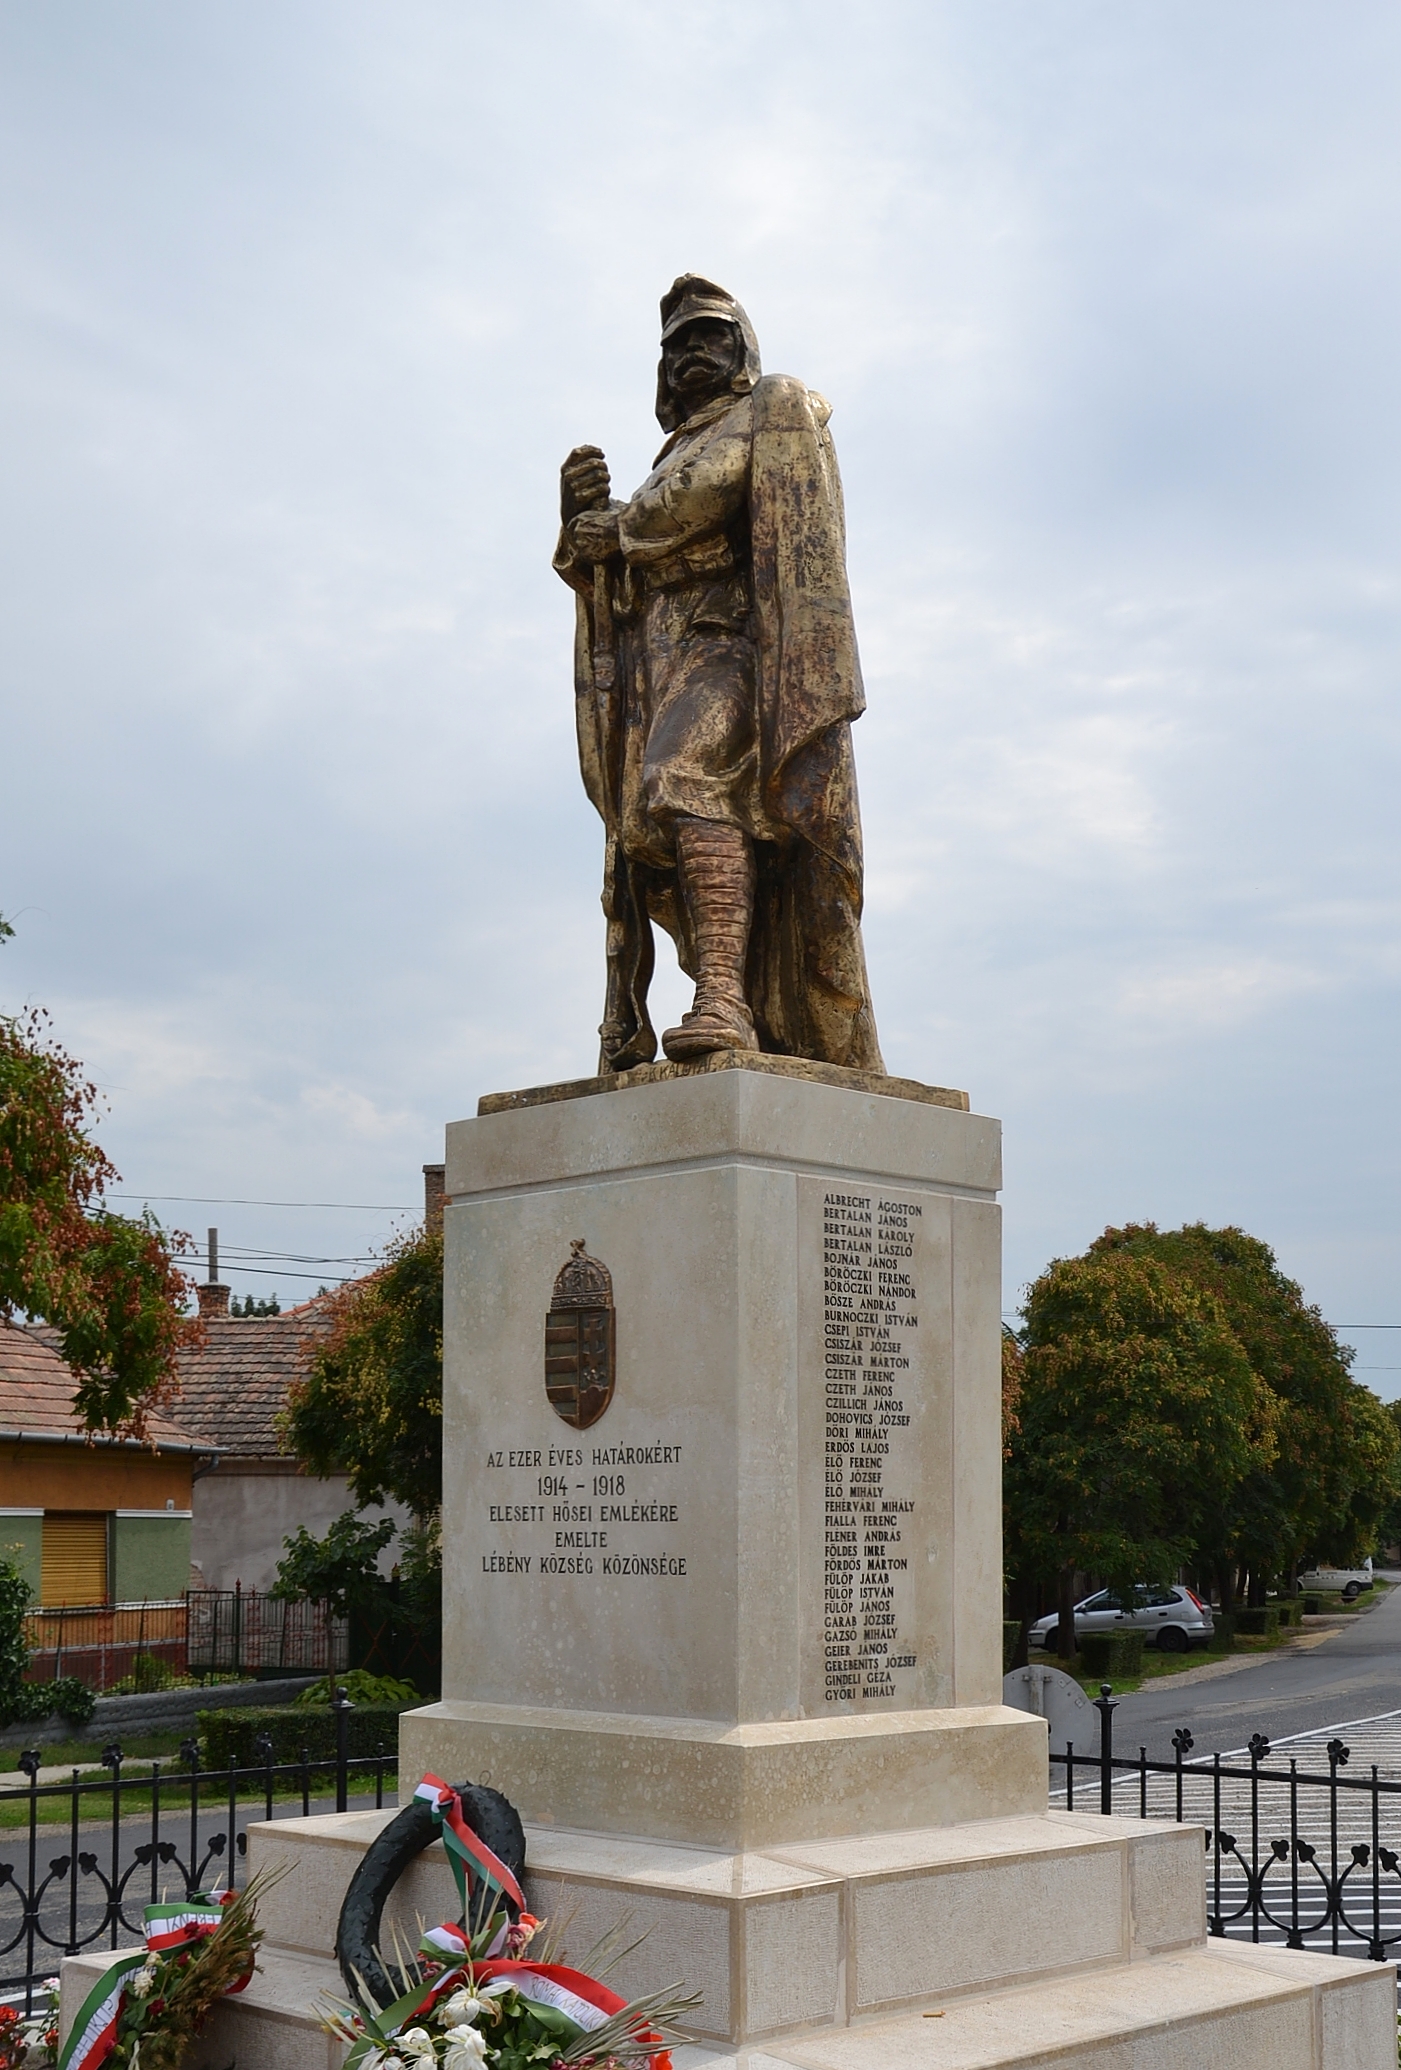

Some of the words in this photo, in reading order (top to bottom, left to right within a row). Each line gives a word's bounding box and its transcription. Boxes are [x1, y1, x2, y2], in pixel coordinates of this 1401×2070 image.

[824, 1194, 871, 1209] ALBRECHT
[878, 1197, 922, 1216] ÁGOSTON
[824, 1208, 871, 1223] BERTALAN
[878, 1213, 908, 1227] JÁNOS
[824, 1223, 871, 1238] BERTALAN
[878, 1227, 914, 1243] KÁROLY
[824, 1238, 871, 1253] BERTALAN
[878, 1242, 912, 1257] LÁSZLÓ
[824, 1252, 861, 1266] BOJNÁR
[868, 1254, 897, 1269] JÁNOS
[879, 1272, 910, 1285] FERENC
[879, 1284, 916, 1299] NÁNDOR
[860, 1298, 896, 1311] ANDRÁS
[825, 1310, 878, 1324] BURNOCZKI
[885, 1313, 918, 1327] ISTVÁN
[825, 1324, 849, 1336] CSEPI
[856, 1325, 889, 1338] ISTVÁN
[825, 1337, 863, 1351] CSISZÁR
[870, 1339, 901, 1353] JÓZSEF
[825, 1352, 863, 1366] CSISZÁR
[870, 1354, 909, 1368] MÁRTON
[826, 1368, 856, 1380] CZETH
[863, 1371, 895, 1382] FERENC
[826, 1383, 856, 1395] CZETH
[863, 1382, 893, 1396] JÁNOS
[826, 1398, 866, 1410] CZILLICH
[874, 1398, 903, 1411] JÁNOS
[826, 1412, 872, 1424] DOHOVICS
[879, 1412, 910, 1426] JÓZSEF
[855, 1425, 888, 1439] MIHÁLY
[487, 1452, 503, 1467] AZ
[509, 1451, 541, 1467] EZER
[549, 1444, 583, 1465] ÉVES
[593, 1440, 682, 1465] HATÁROKÉRT
[861, 1443, 889, 1453] LAJOS
[850, 1457, 882, 1468] FERENC
[850, 1469, 881, 1483] JÓZSEF
[538, 1476, 568, 1496] 1914
[593, 1475, 625, 1496] 1918
[850, 1484, 883, 1497] MIHÁLY
[490, 1506, 544, 1521] ELESETT
[600, 1500, 678, 1522] EMLÉKÉRE
[825, 1498, 874, 1512] FEHÉRVÁRI
[882, 1498, 915, 1512] MIHÁLY
[825, 1516, 856, 1526] FIALLA
[863, 1516, 897, 1526] FERENC
[556, 1532, 607, 1547] EMELTE
[865, 1528, 901, 1542] ANDRÁS
[864, 1546, 885, 1556] IMRE
[483, 1551, 531, 1572] LÉBÉNY
[540, 1553, 593, 1574] KÖZSÉG
[603, 1553, 687, 1575] KÖZÖNSÉGE
[867, 1557, 907, 1570] MÁRTON
[860, 1573, 889, 1584] JAKAB
[860, 1585, 893, 1598] ISTVÁN
[860, 1598, 889, 1612] JÁNOS
[825, 1616, 857, 1627] GARAB
[863, 1613, 895, 1626] JÓZSEF
[825, 1627, 857, 1641] GAZSÓ
[864, 1626, 897, 1640] MIHÁLY
[825, 1646, 850, 1657] GEIER
[858, 1641, 887, 1655] JÁNOS
[825, 1659, 878, 1672] GEREBENITS
[885, 1654, 917, 1668] JÓZSEF
[825, 1674, 860, 1686] GINDELI
[867, 1670, 891, 1683] GÉZA
[863, 1684, 896, 1698] MIHÁLY
